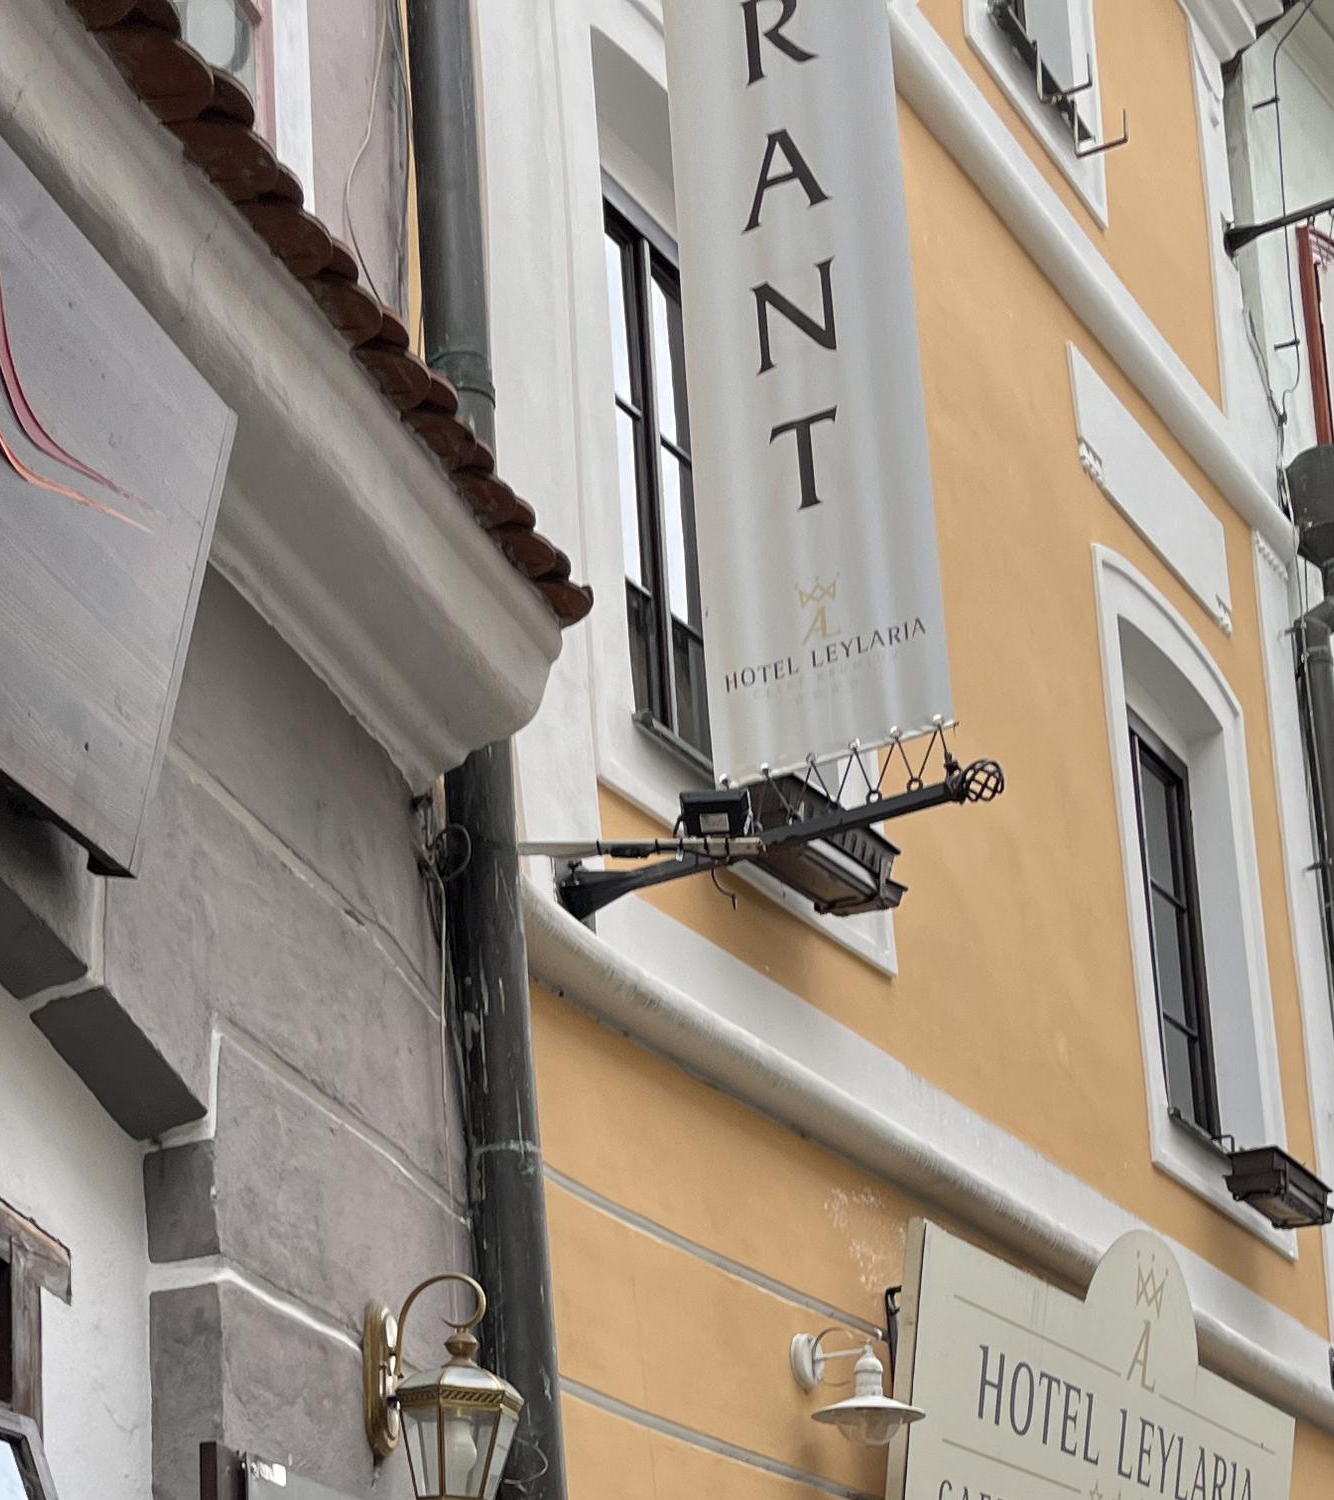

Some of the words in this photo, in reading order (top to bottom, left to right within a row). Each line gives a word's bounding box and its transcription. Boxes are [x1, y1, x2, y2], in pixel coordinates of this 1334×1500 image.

[724, 656, 800, 694] HOTEL
[811, 616, 926, 669] LEYLARIA
[977, 1344, 1100, 1466] HOTEL
